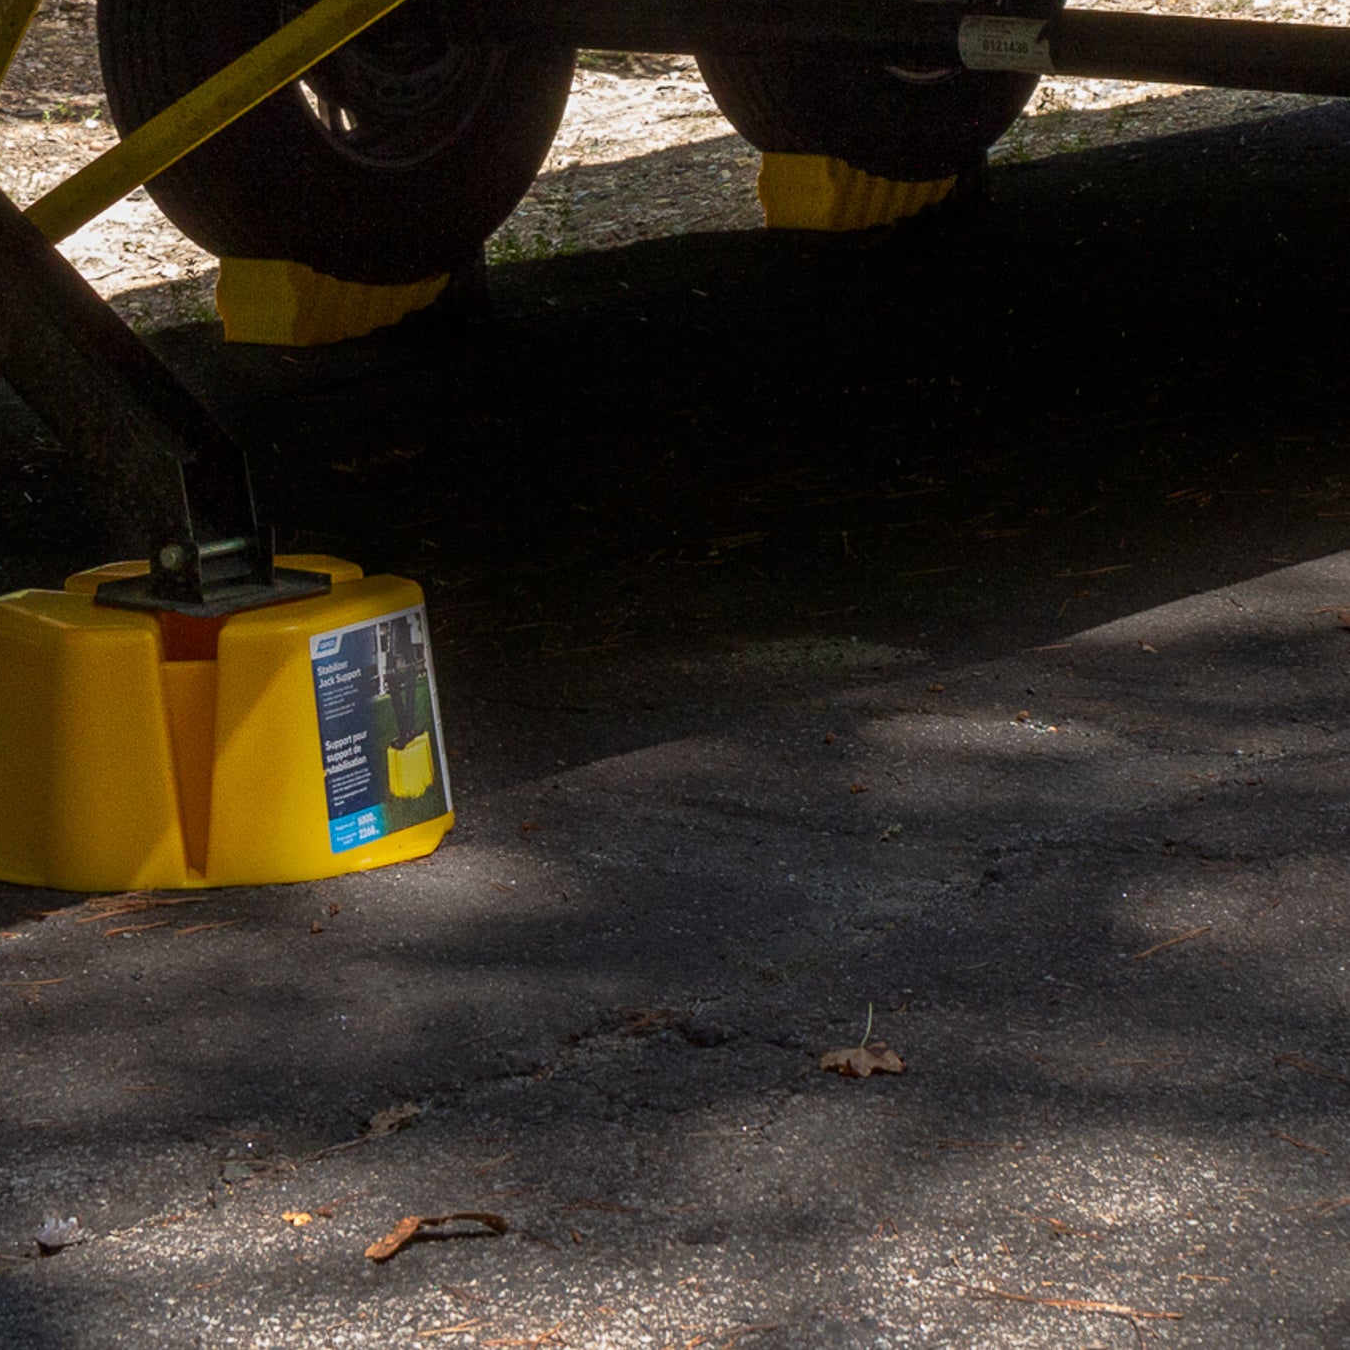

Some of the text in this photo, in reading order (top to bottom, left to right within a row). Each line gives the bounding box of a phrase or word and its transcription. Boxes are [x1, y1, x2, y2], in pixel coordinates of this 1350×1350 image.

[317, 661, 349, 677] Stabilizer
[319, 668, 362, 689] Jack Support
[325, 731, 367, 751] Support pour
[326, 745, 362, 763] support de
